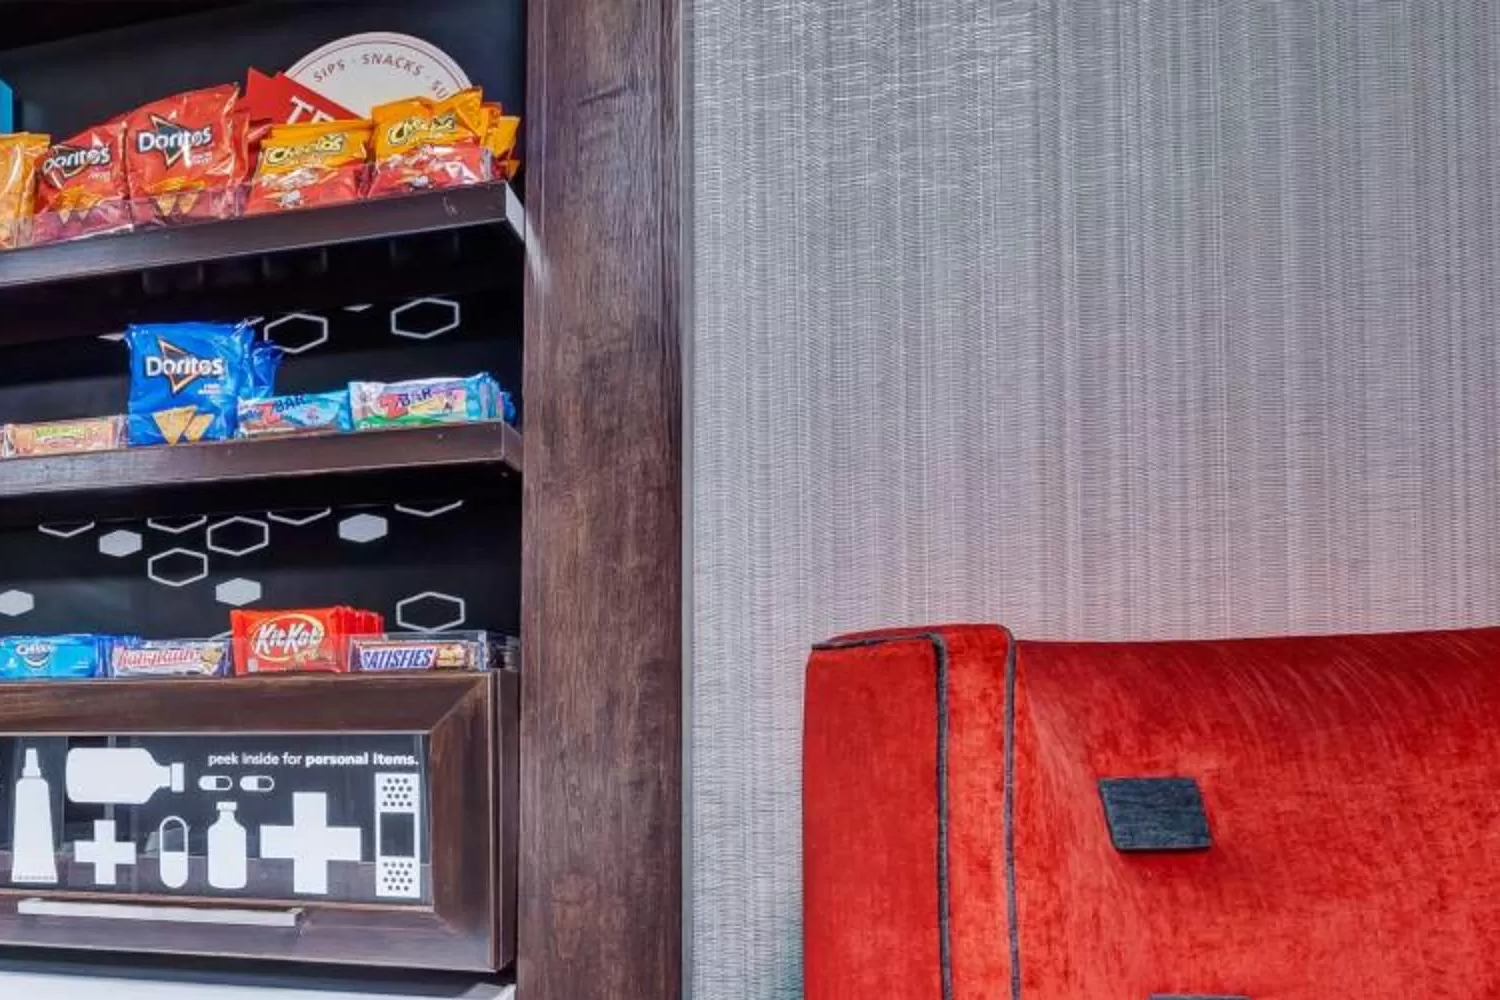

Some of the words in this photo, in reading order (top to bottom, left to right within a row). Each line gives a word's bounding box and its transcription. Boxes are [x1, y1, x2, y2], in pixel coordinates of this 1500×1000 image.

[313, 60, 346, 83] SIPS
[361, 53, 423, 76] SNACKS
[137, 126, 213, 152] Doritos
[145, 355, 224, 377] Doritos
[362, 649, 433, 668] SATISFIES
[207, 752, 239, 767] peek
[241, 752, 280, 765] inside
[282, 752, 302, 765] for
[305, 752, 369, 768] personal
[373, 752, 419, 765] items.
